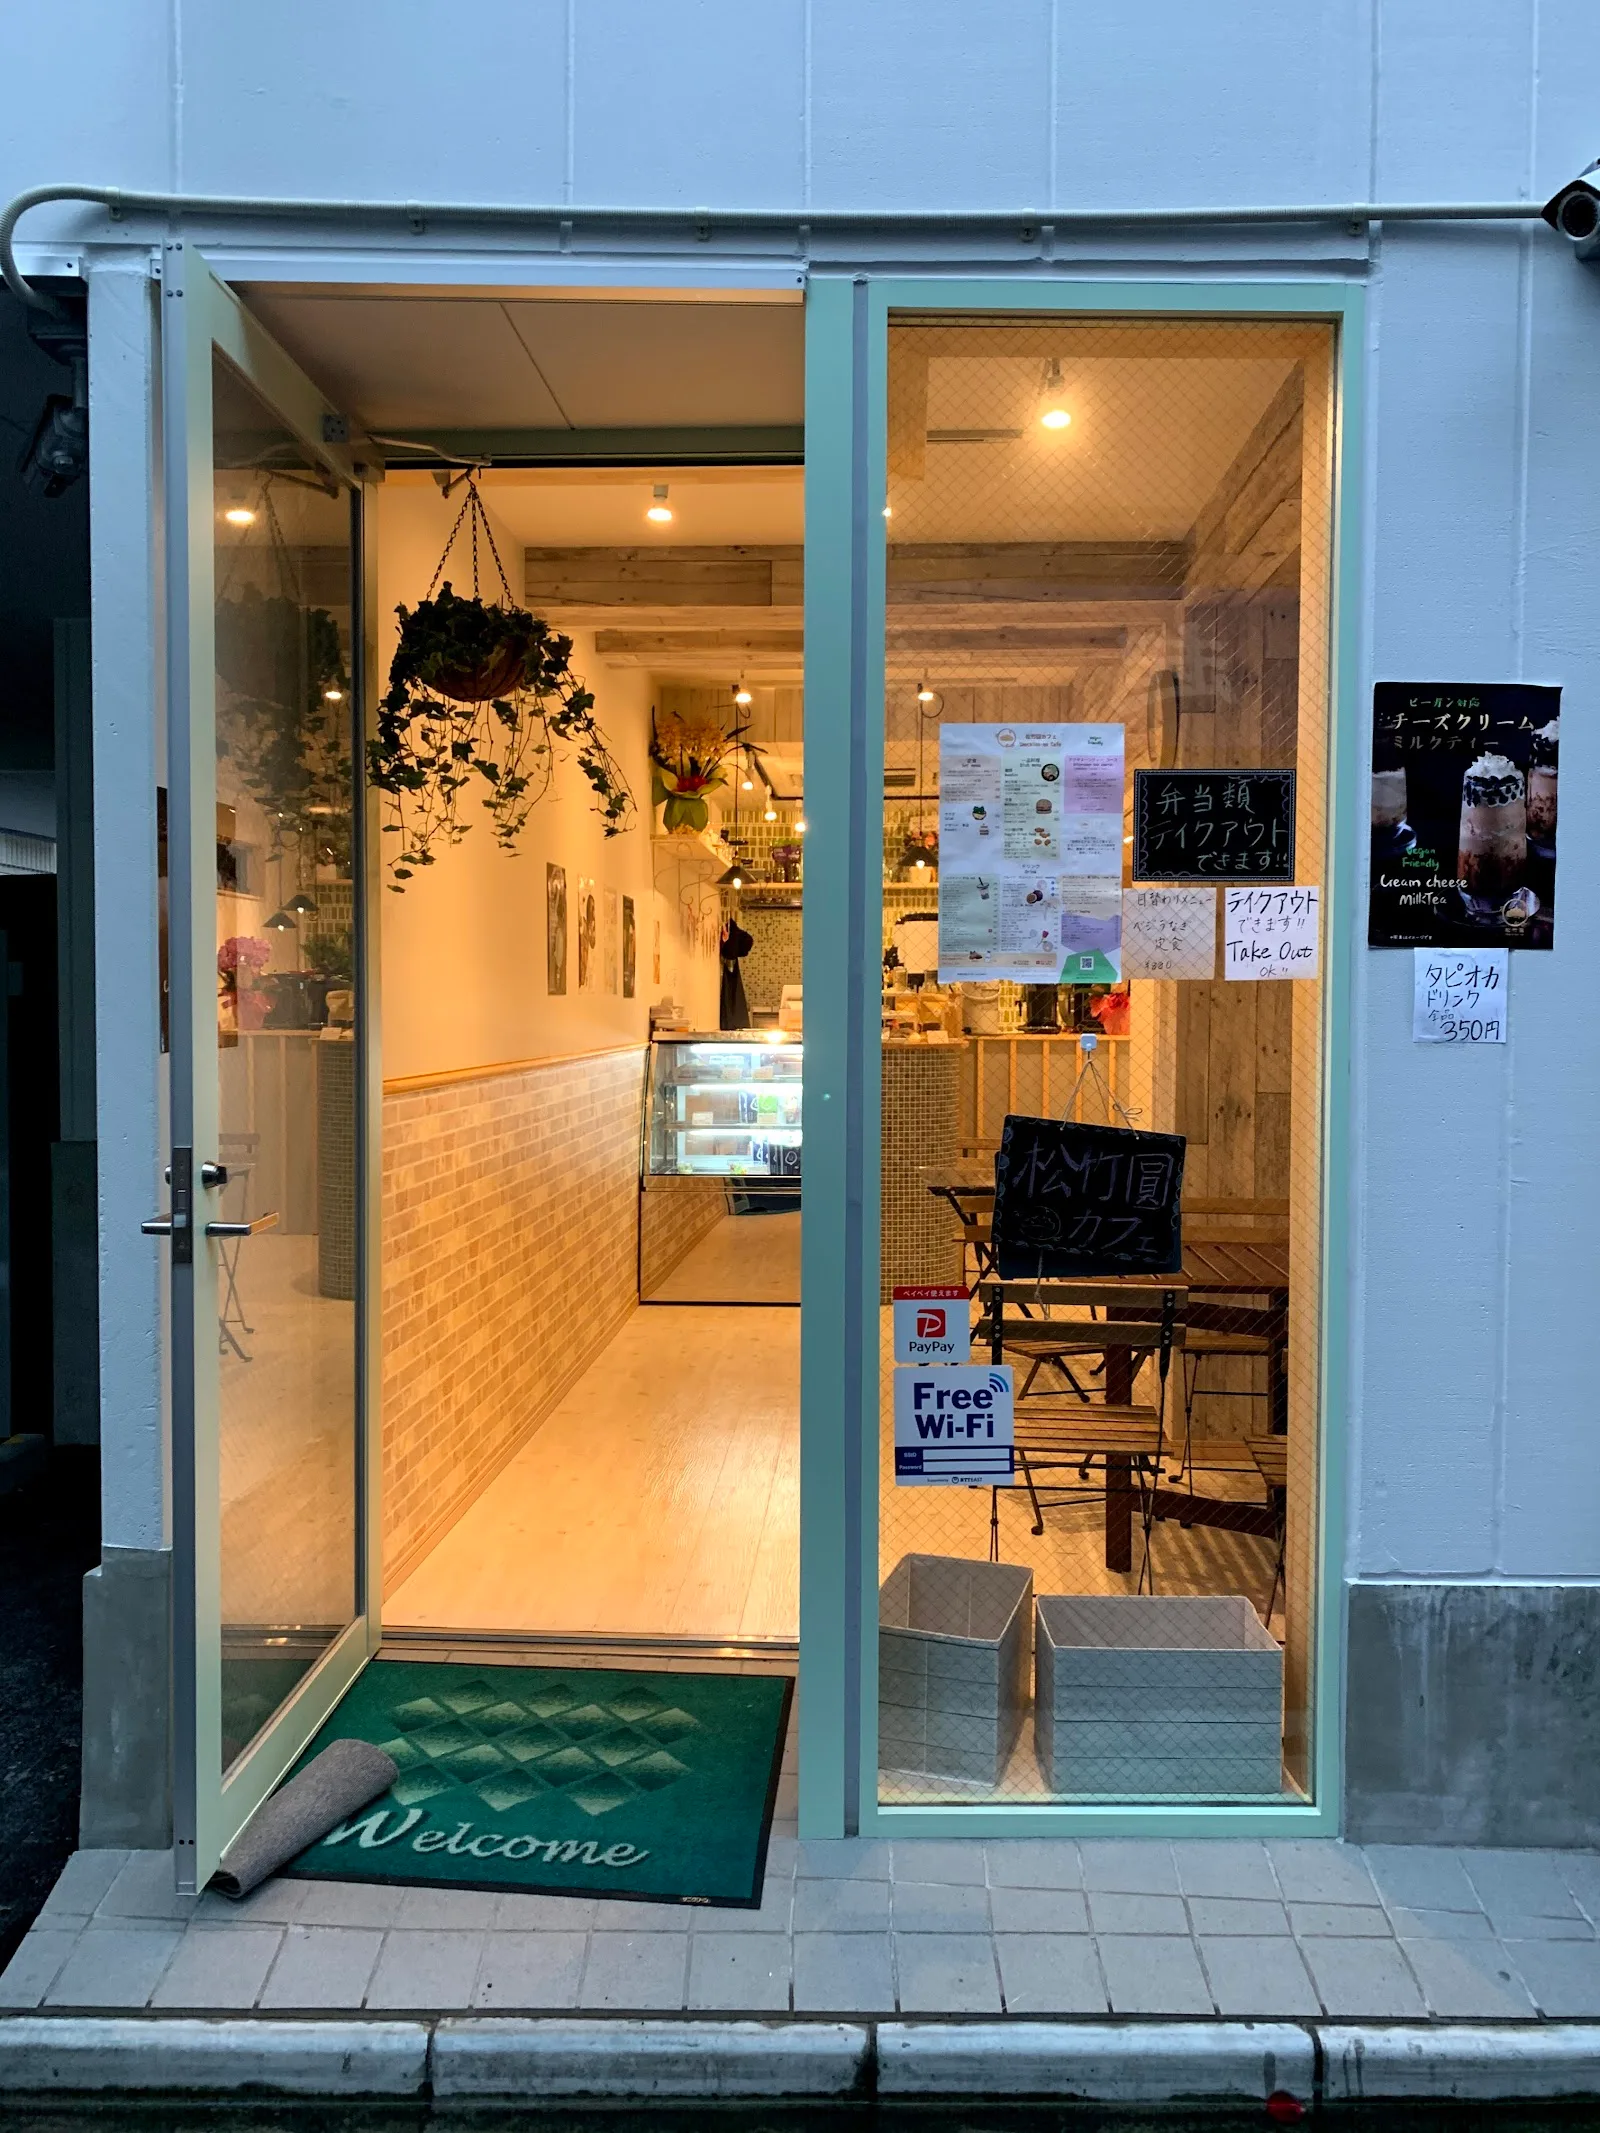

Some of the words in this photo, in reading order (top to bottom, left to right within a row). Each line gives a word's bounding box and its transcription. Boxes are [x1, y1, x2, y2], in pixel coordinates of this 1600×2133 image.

[1392, 713, 1534, 731] チーズクリーム
[1394, 735, 1499, 750] ミルクティー
[1156, 781, 1255, 815] 弁当類
[1148, 817, 1288, 849] テイクアウト
[1402, 857, 1440, 871] Friendly
[1406, 848, 1436, 858] Vegan
[1380, 874, 1421, 888] Cream
[1426, 874, 1468, 888] cheese
[1228, 890, 1318, 915] テイクアウト
[1155, 936, 1183, 951] 定食
[1226, 940, 1272, 962] Take
[1279, 941, 1314, 960] Out
[1425, 963, 1499, 990] タピオカ
[1428, 989, 1480, 1009] ドリンク
[1440, 1019, 1500, 1042] 350円
[1068, 1208, 1159, 1254] カフェ
[909, 1341, 955, 1354] PayPay
[913, 1382, 993, 1410] Free
[914, 1413, 994, 1439] Wi-Fi
[324, 1807, 649, 1867] Welcome
